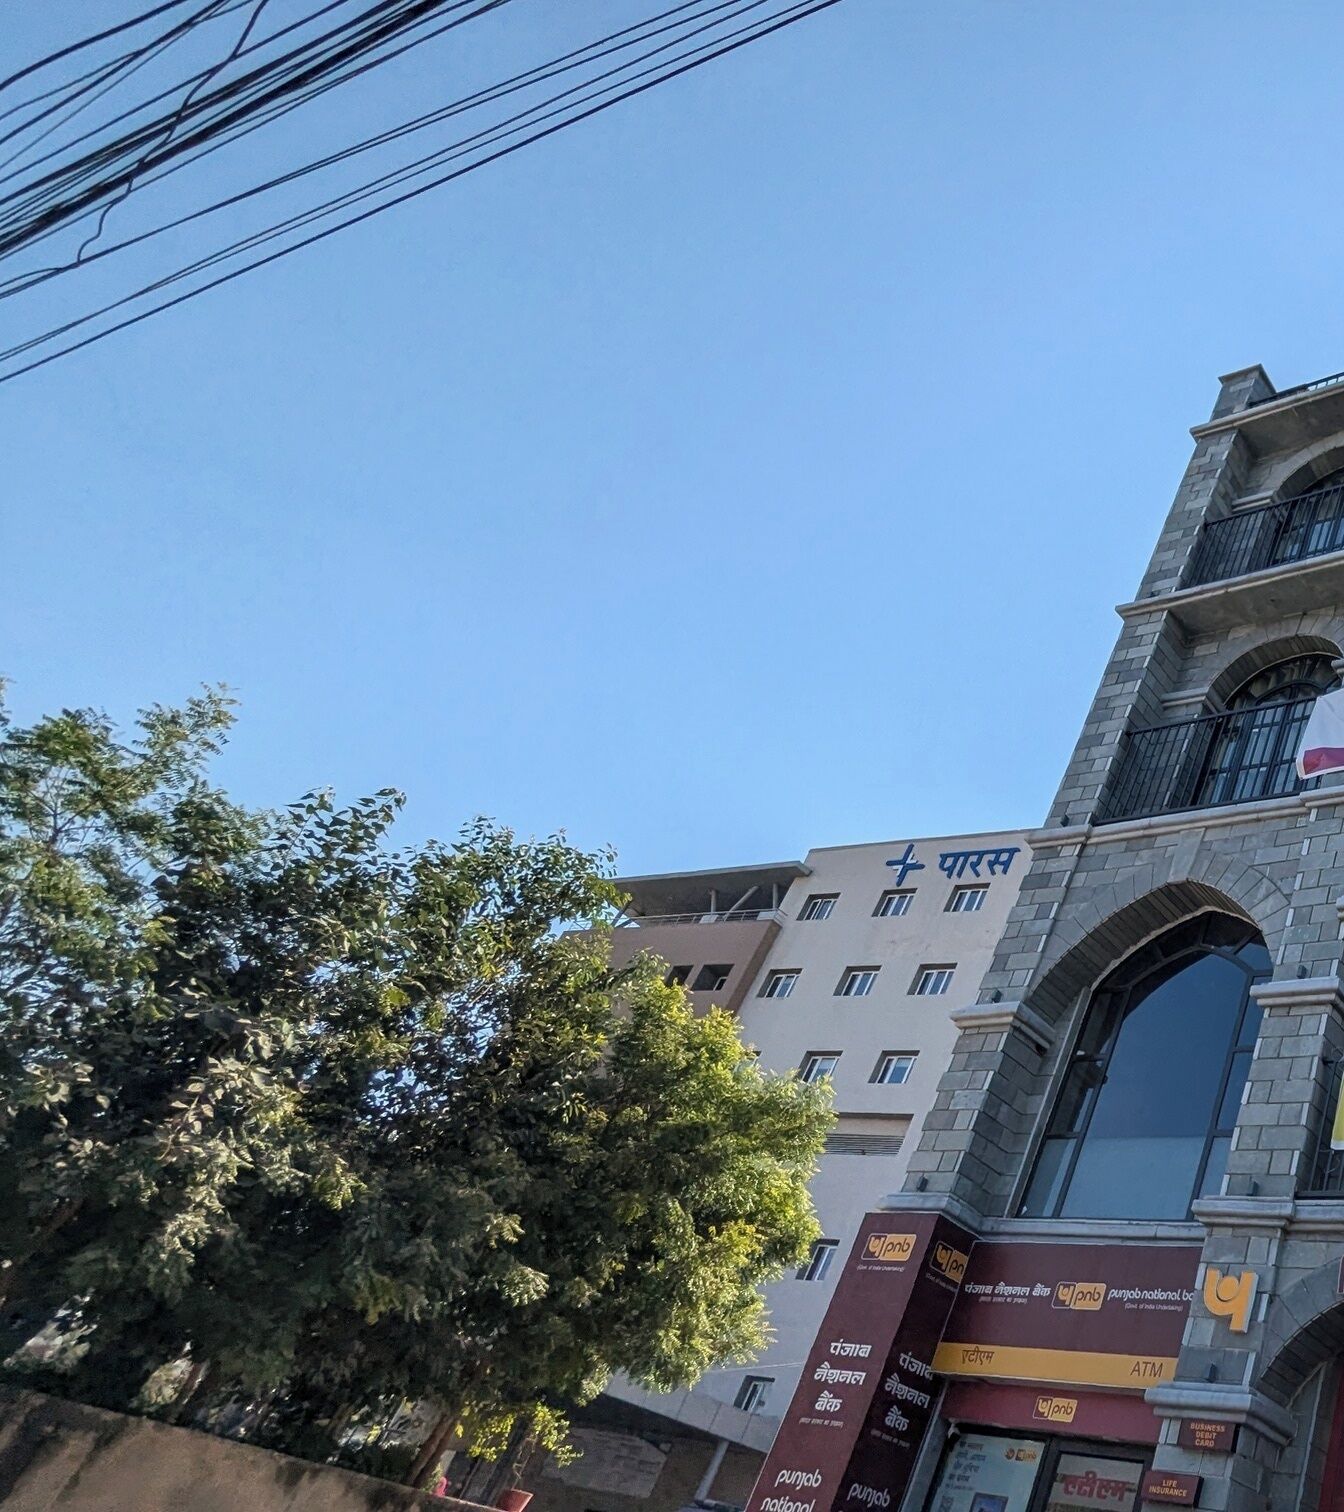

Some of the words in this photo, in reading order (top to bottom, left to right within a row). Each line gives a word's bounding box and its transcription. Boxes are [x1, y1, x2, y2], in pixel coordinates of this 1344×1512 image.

[938, 847, 1021, 879] पारस
[1074, 1287, 1100, 1308] pnb
[1107, 1288, 1141, 1301] punjab
[1141, 1288, 1181, 1301] national
[830, 1339, 872, 1358] पंजाब
[961, 1346, 995, 1365] एटीएम
[1130, 1361, 1164, 1378] ATM
[814, 1361, 866, 1385] नैशनल
[815, 1390, 842, 1412] बैंक
[884, 1373, 931, 1409] नैशनल
[884, 1405, 909, 1431] बैंक
[1051, 1401, 1073, 1416] pnb
[1190, 1422, 1226, 1433] BUSINESS
[1195, 1432, 1217, 1440] DEBIT
[1195, 1440, 1215, 1448] CARD
[774, 1469, 822, 1490] punjab
[847, 1483, 890, 1508] punjab
[1149, 1486, 1188, 1497] INSURANCE
